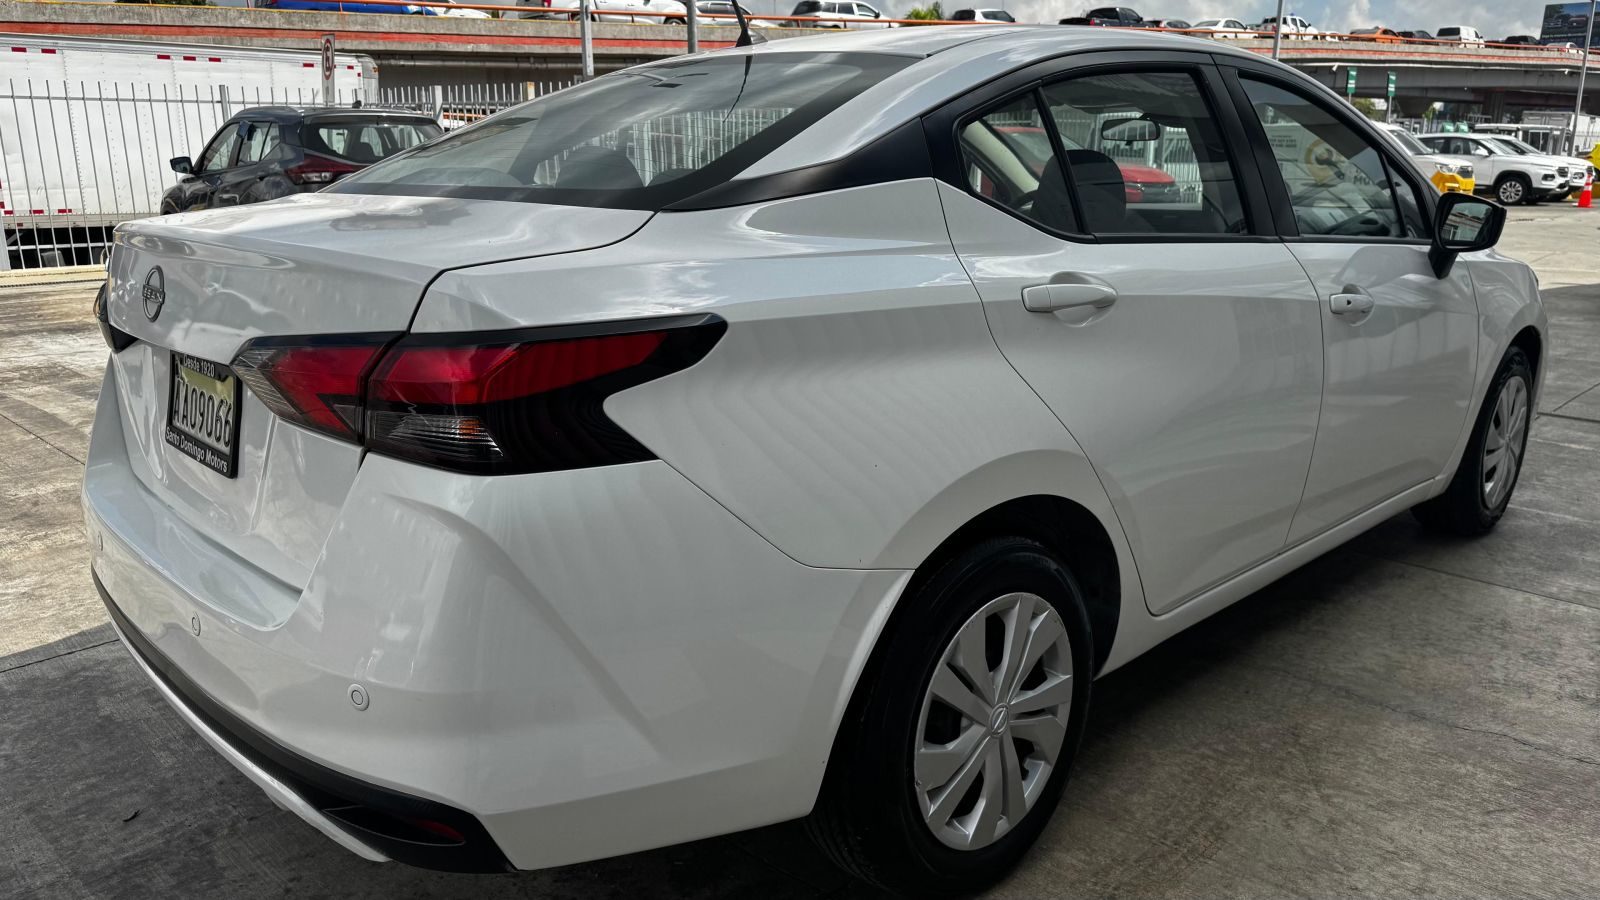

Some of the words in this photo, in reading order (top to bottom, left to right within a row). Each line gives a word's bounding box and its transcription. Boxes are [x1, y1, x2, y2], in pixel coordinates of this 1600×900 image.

[183, 354, 200, 373] Desde
[201, 360, 215, 377] 1920
[166, 426, 180, 446] Santo
[180, 435, 205, 462] Domingo
[205, 449, 228, 473] Motors
